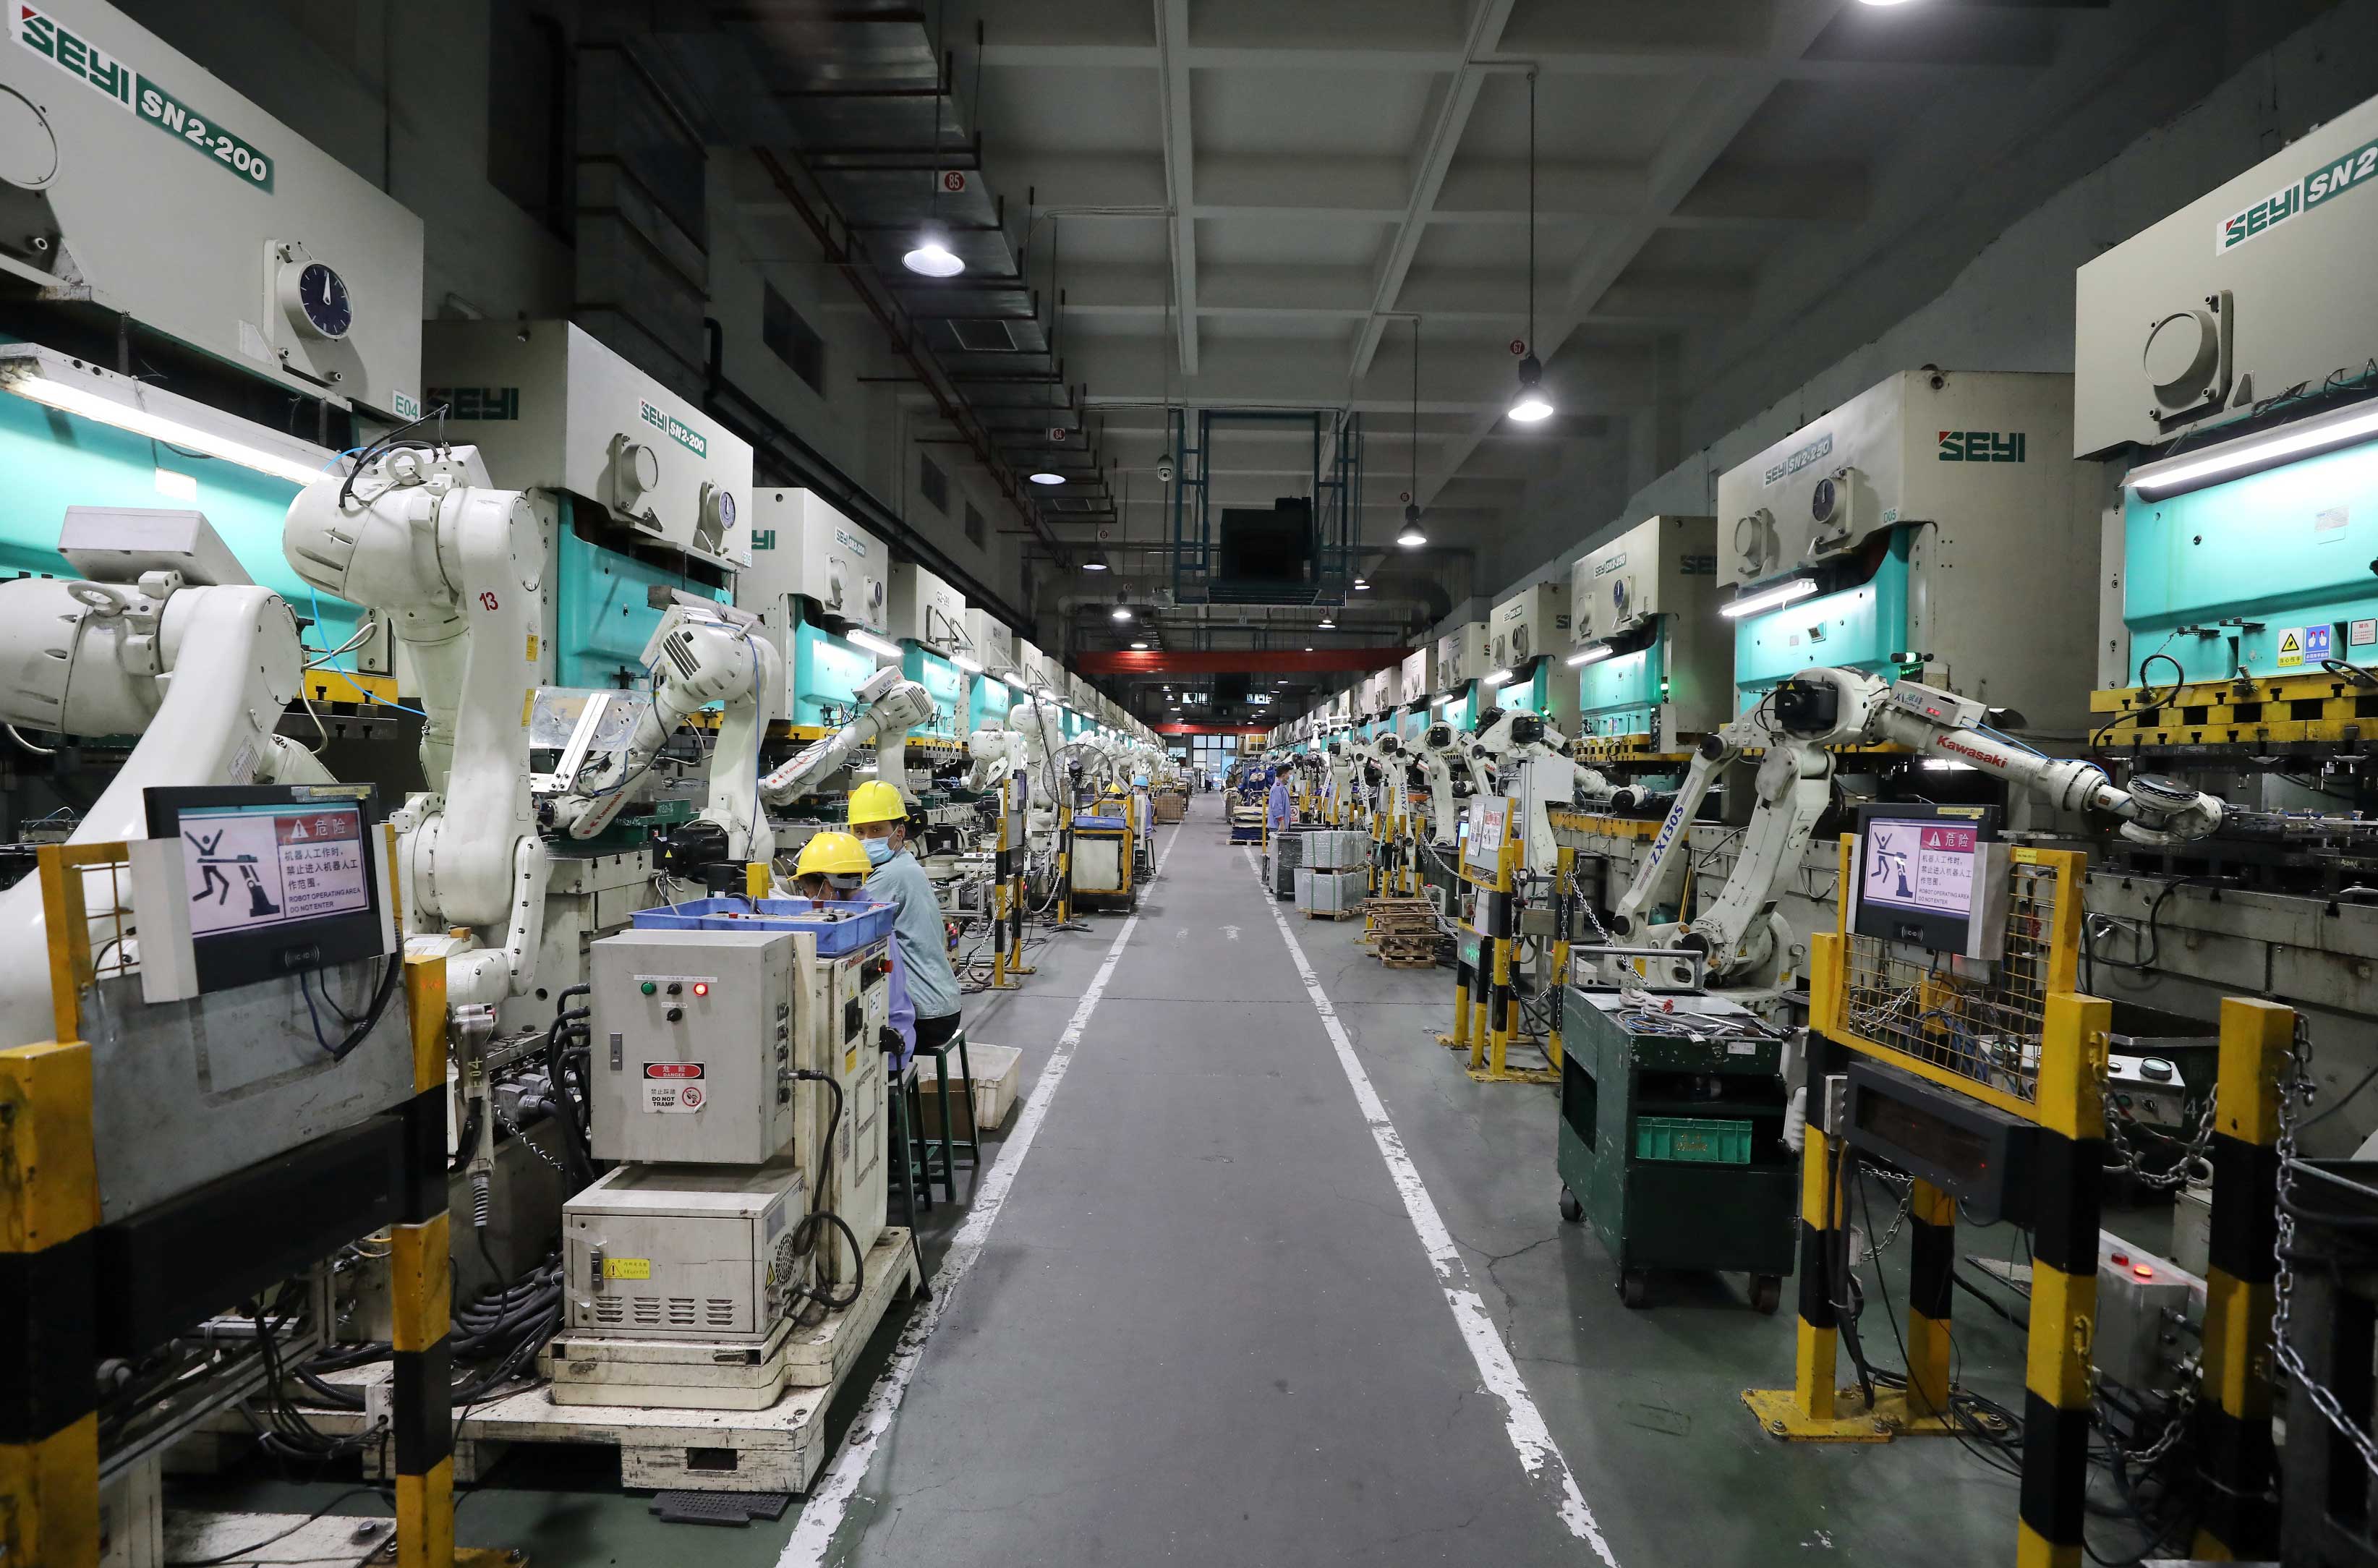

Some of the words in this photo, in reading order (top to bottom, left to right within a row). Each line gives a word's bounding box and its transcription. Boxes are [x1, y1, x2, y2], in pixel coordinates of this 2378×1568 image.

[22, 5, 129, 105] SEYI
[140, 89, 268, 182] SN2-200
[949, 174, 960, 188] 85
[2225, 184, 2300, 248] SEYI
[1514, 343, 1522, 353] 67
[396, 395, 418, 419] E04
[427, 388, 519, 420] SEYI
[642, 400, 667, 433] SEYI
[670, 421, 704, 453] SN2-200
[1939, 431, 2025, 463] SEYI
[1765, 460, 1787, 485] SEYI
[1789, 438, 1831, 471] SN2-250
[1883, 509, 1896, 524] D05
[1680, 555, 1718, 574] SE
[480, 592, 498, 610] 13
[1936, 735, 2008, 768] Kawasaki
[595, 791, 625, 820] Kawasaki
[315, 818, 346, 836] 危险
[1650, 805, 1684, 866] ZX130S
[1946, 831, 1969, 848] 危险
[286, 859, 358, 876] 禁止进入机器人工
[289, 894, 310, 903] ROBOT
[312, 889, 346, 900] OPERATING
[345, 887, 361, 895] AREA
[300, 903, 313, 912] NOT
[314, 901, 334, 910] ENTER
